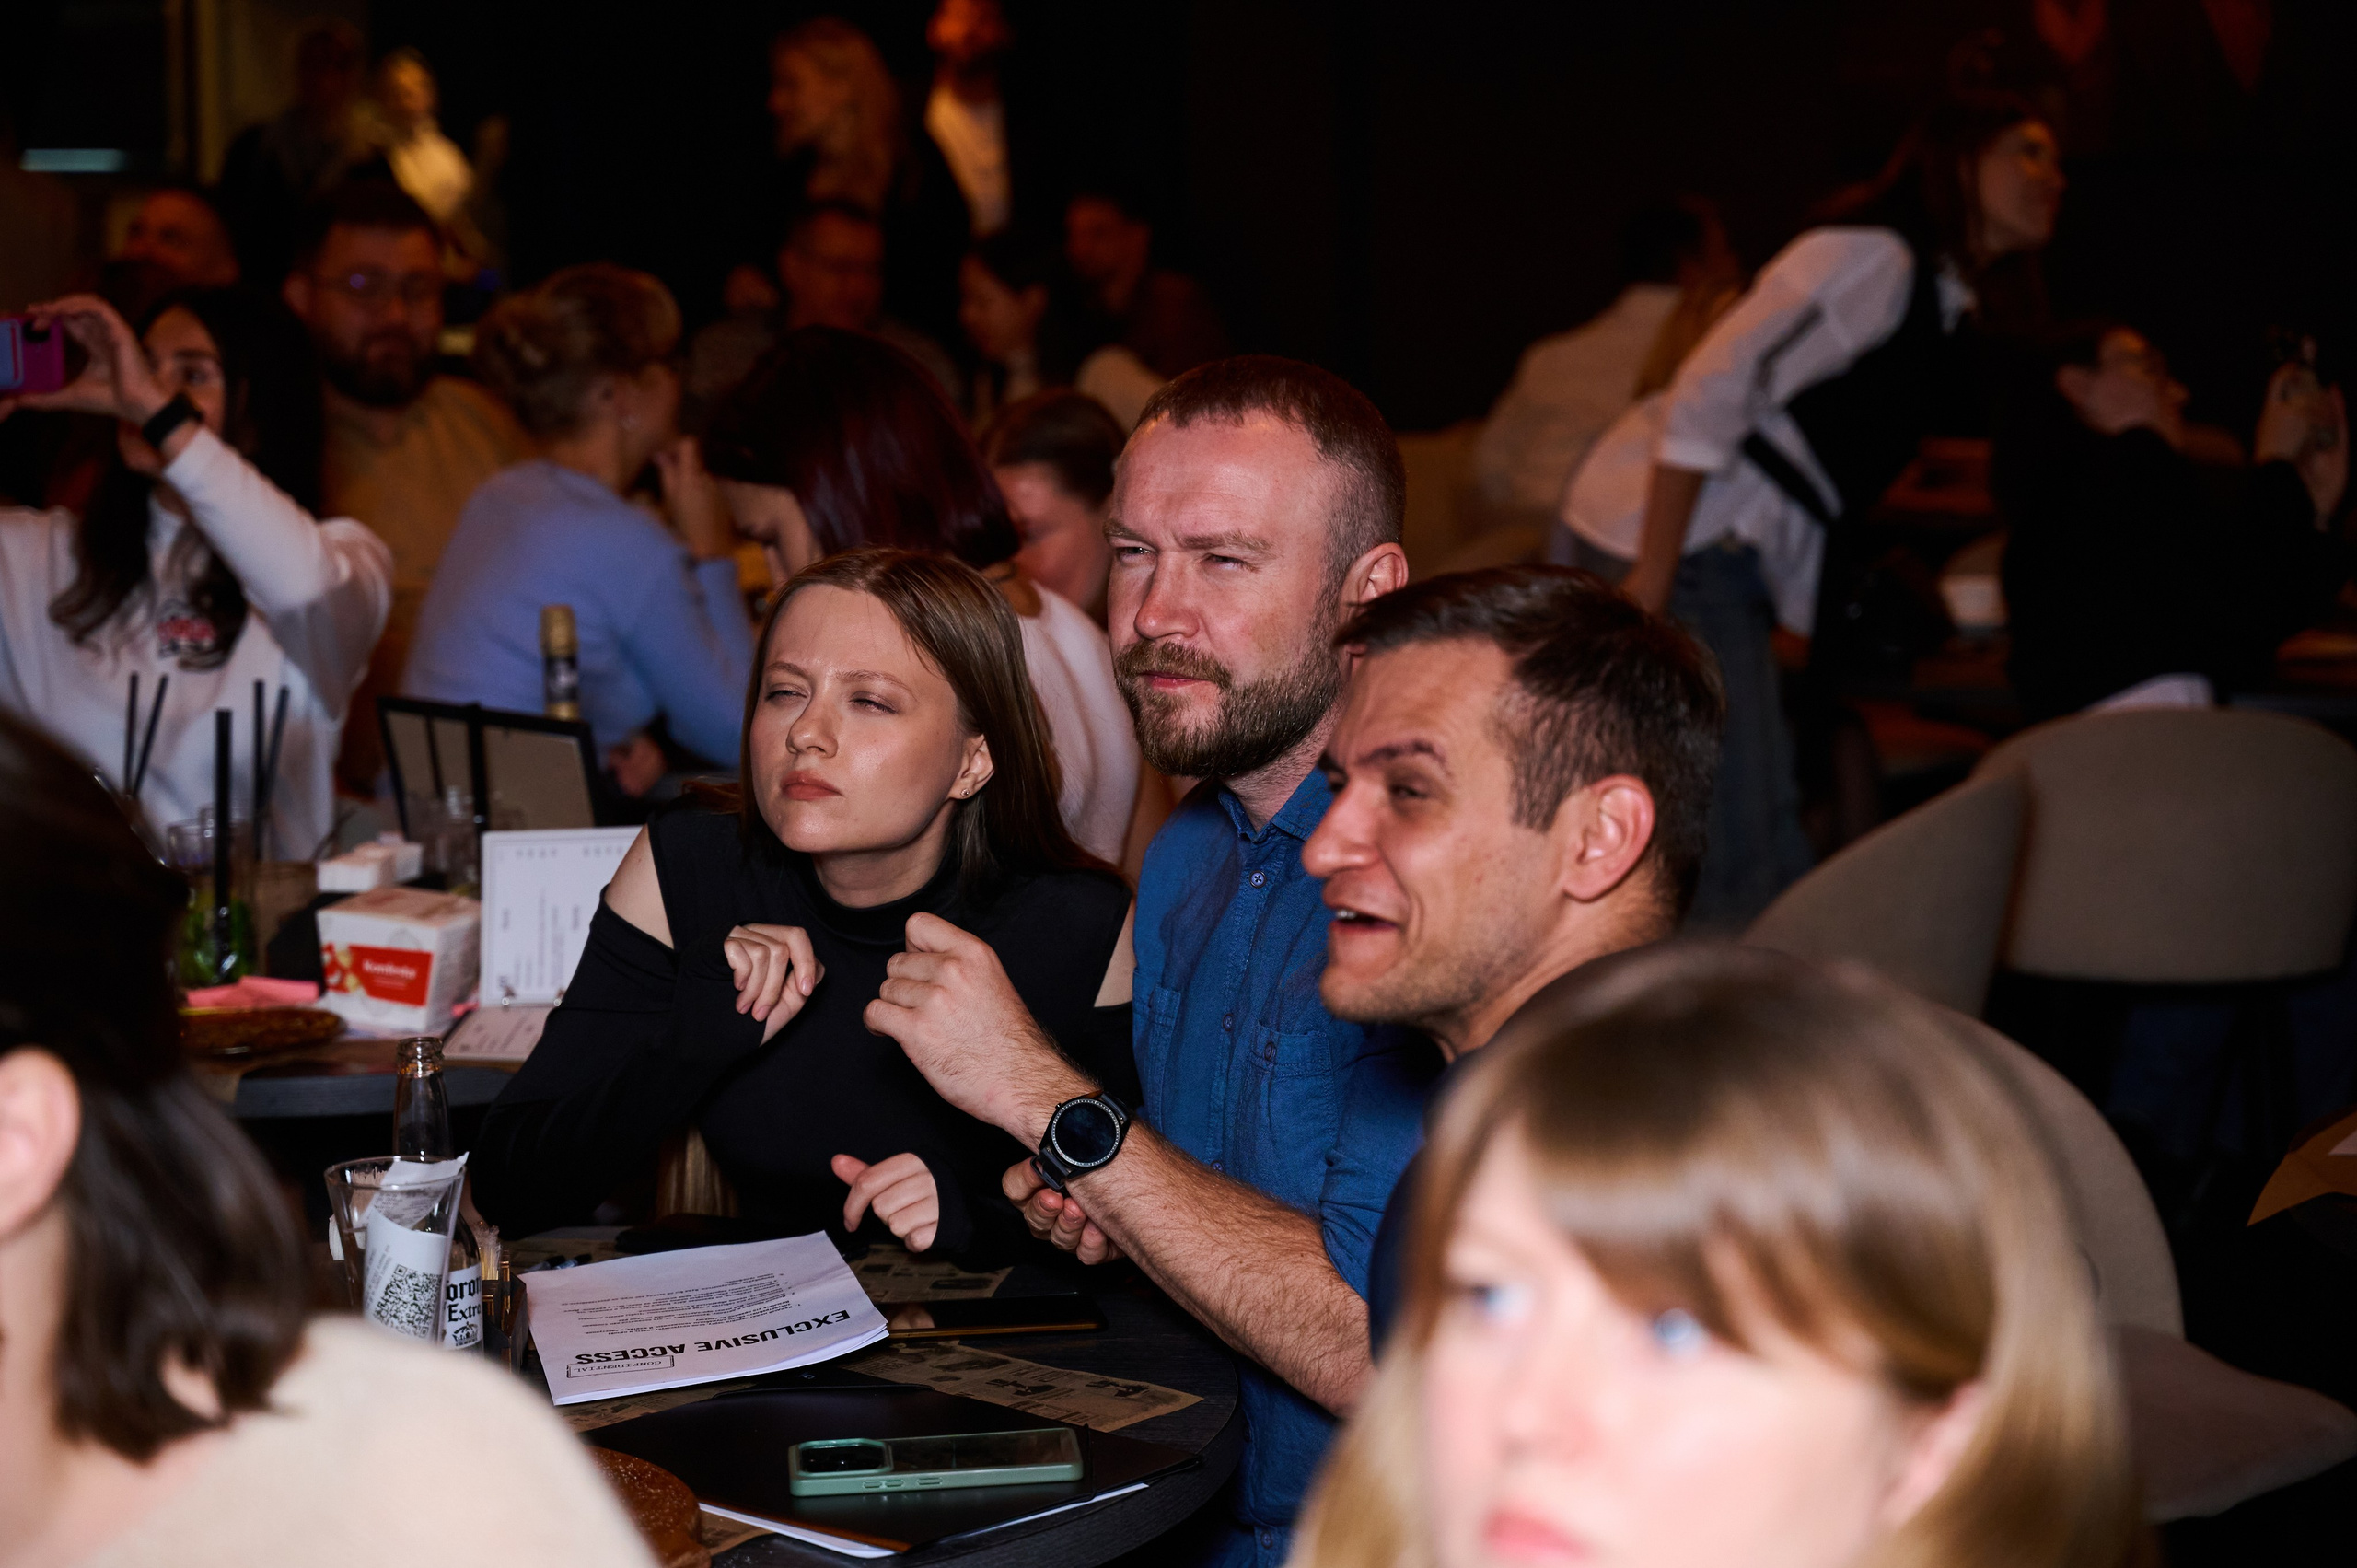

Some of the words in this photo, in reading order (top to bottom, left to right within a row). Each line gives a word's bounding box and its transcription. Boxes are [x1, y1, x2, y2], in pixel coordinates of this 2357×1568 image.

[694, 1309, 851, 1352] EXCLUSIVE
[575, 1343, 686, 1365] ACCESS
[574, 1360, 662, 1373] CONFIDENTIAL
